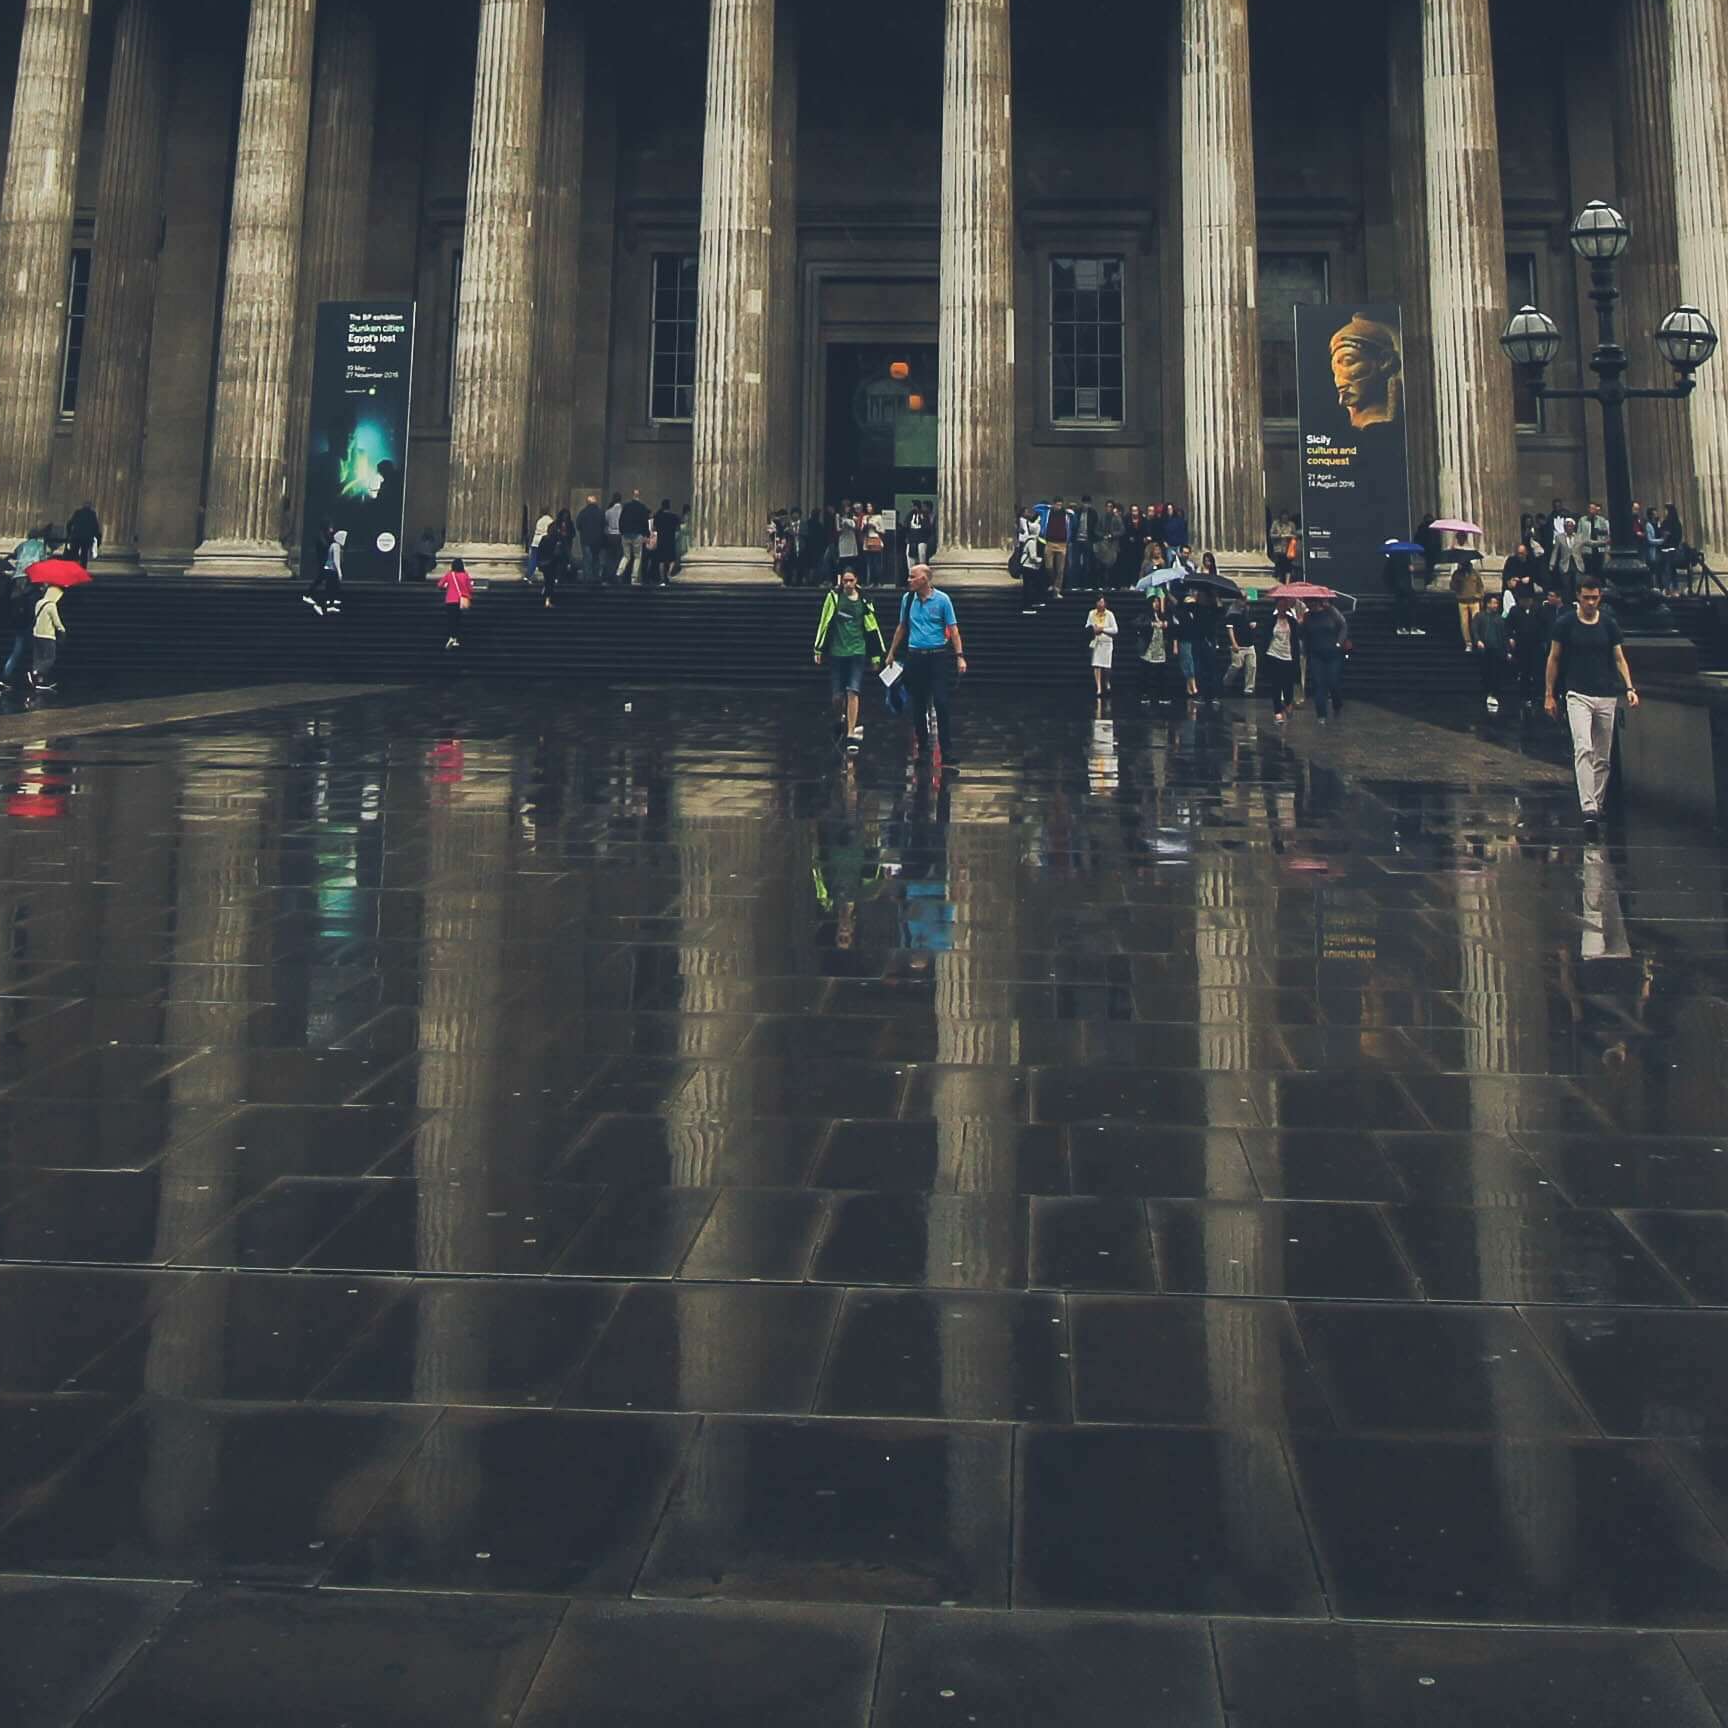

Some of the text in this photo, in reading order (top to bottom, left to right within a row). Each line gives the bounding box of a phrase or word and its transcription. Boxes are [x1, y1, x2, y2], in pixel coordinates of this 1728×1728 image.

[349, 323, 405, 332] Sunken cities
[348, 333, 396, 343] Egypt's lost
[346, 344, 376, 352] worlds
[1306, 434, 1331, 446] Sicily
[1306, 446, 1357, 454] culture and
[1306, 457, 1349, 467] conquest
[1317, 473, 1332, 481] April
[1316, 481, 1338, 489] August
